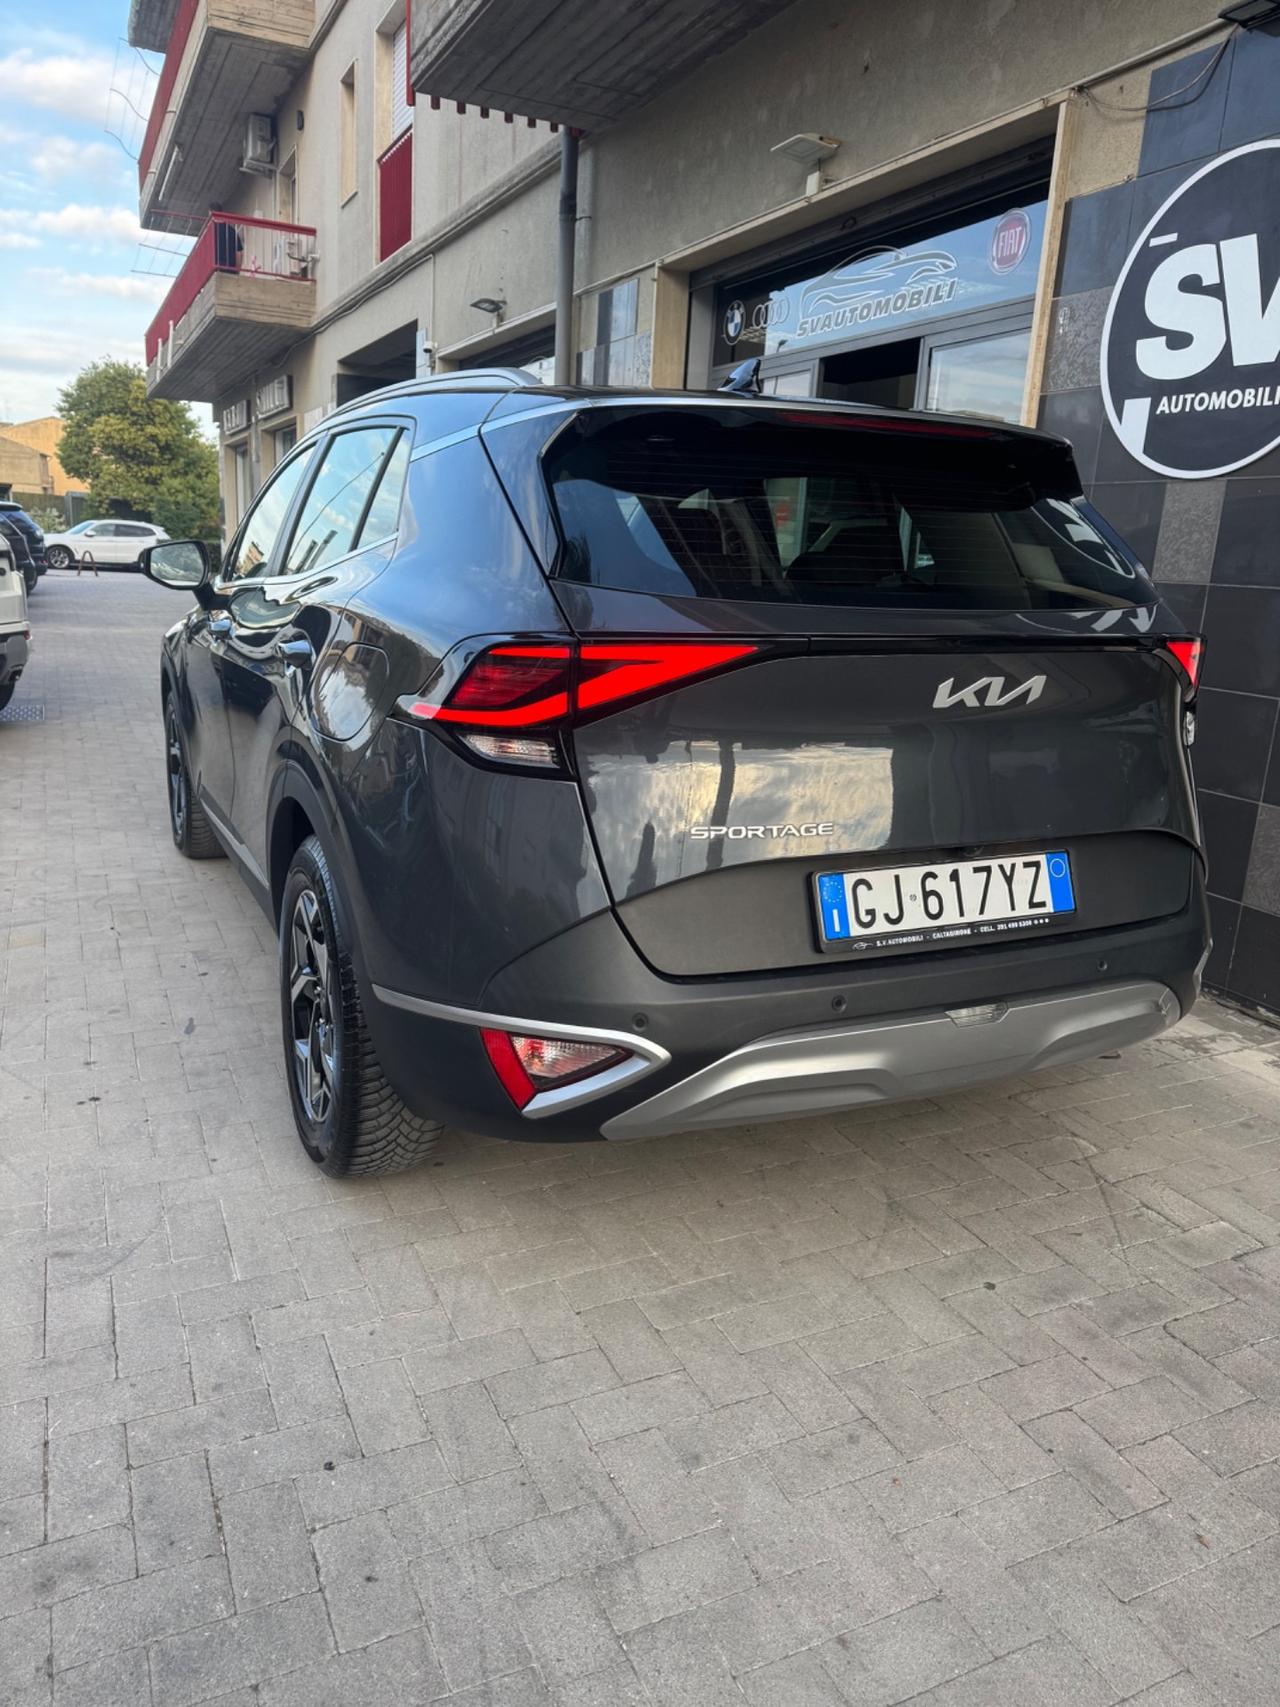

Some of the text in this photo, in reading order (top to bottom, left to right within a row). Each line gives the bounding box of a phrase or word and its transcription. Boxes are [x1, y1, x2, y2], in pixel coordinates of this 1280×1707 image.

[997, 226, 1022, 258] FIAT
[932, 675, 1047, 709] KIA
[690, 822, 834, 840] SPORTAGE
